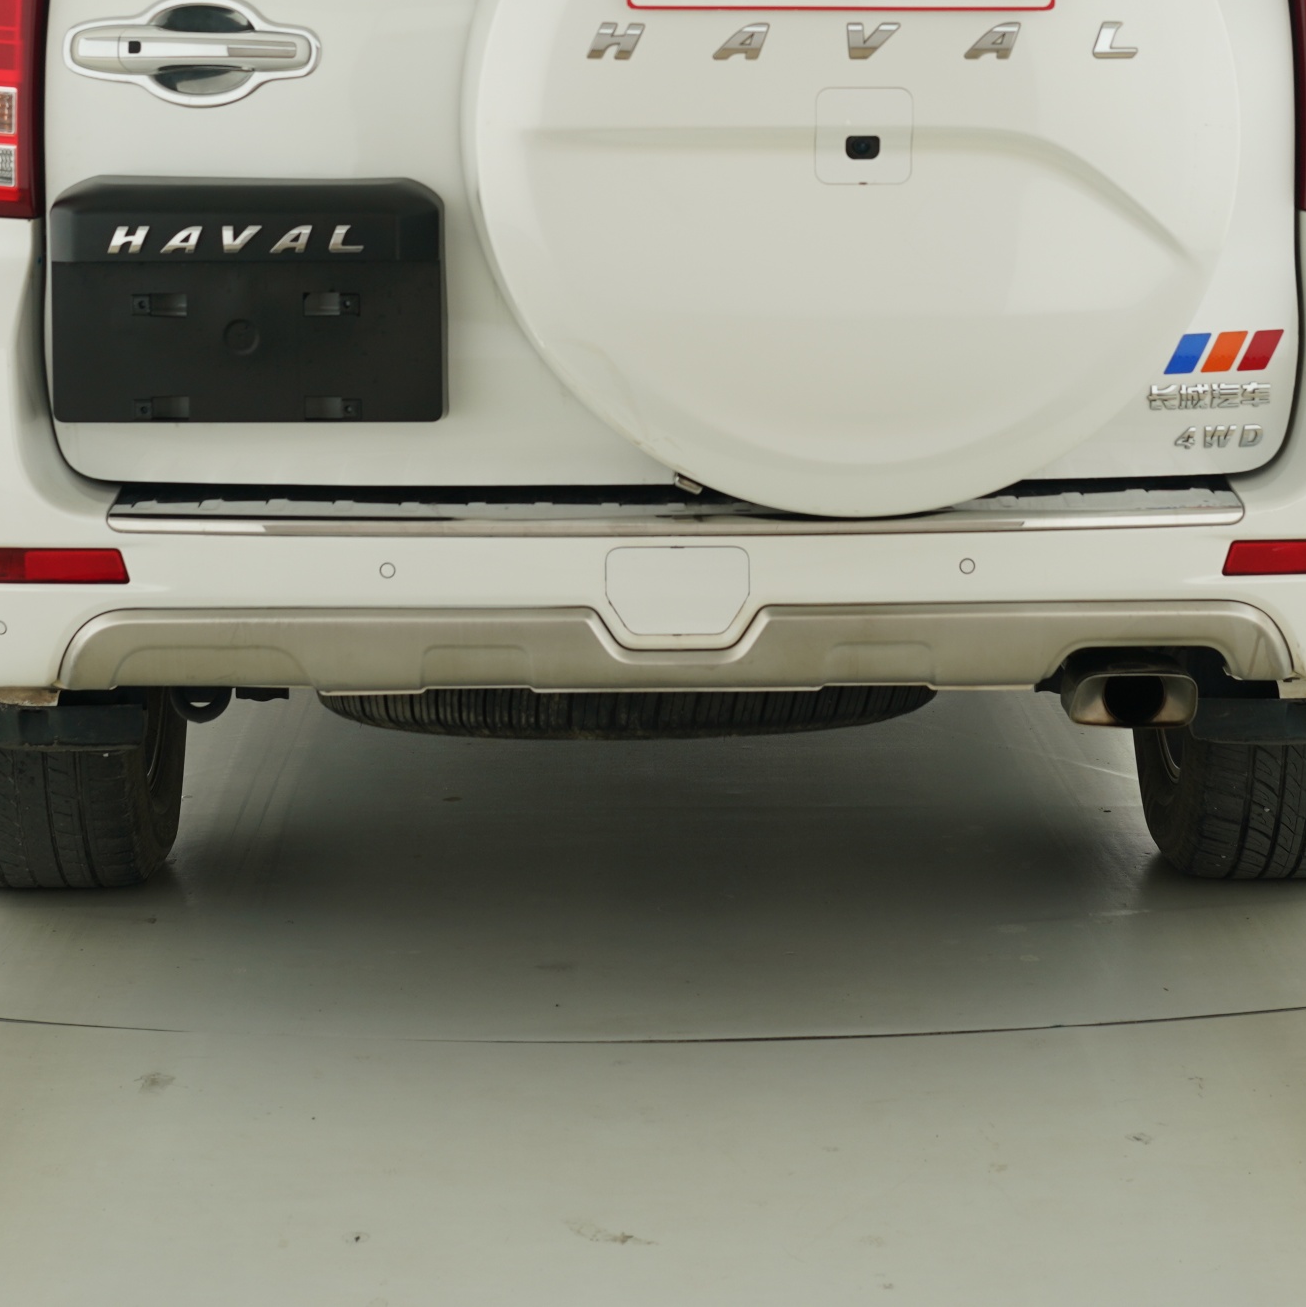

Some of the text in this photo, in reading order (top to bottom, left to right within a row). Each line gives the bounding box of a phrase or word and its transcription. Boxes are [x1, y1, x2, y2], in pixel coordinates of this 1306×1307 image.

[586, 21, 1138, 60] HAVAL
[108, 225, 364, 254] HAVAL
[1147, 382, 1271, 410] 长城汽车
[1174, 424, 1264, 449] 4WD
